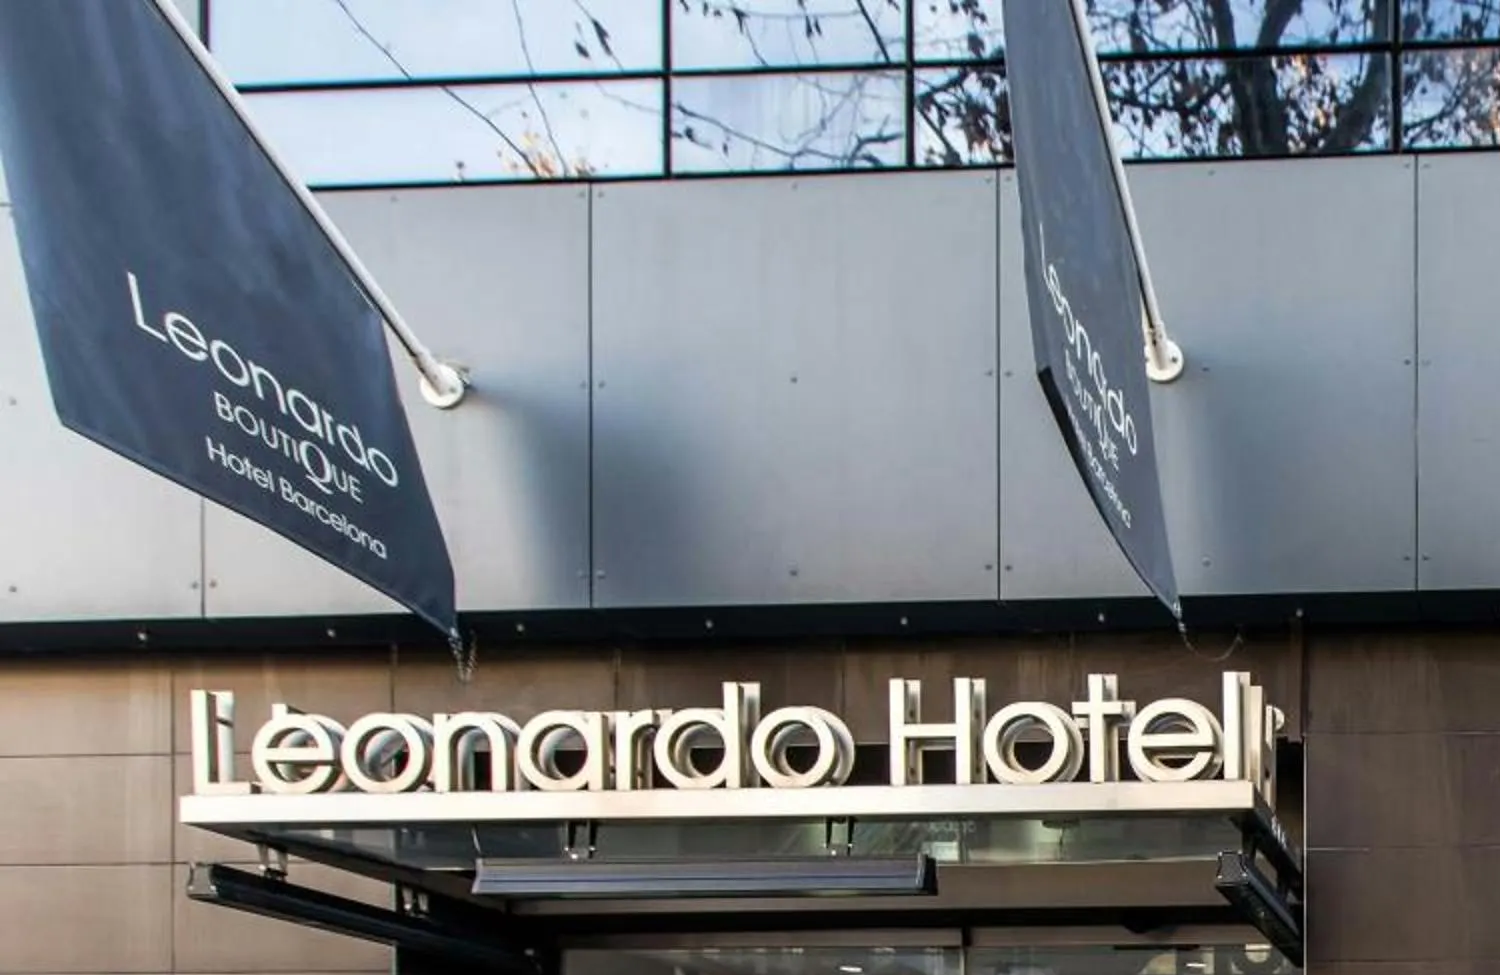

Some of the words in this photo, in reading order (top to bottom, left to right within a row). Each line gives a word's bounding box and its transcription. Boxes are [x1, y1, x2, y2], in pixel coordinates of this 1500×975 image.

[127, 271, 398, 487] Leonardo
[205, 436, 274, 492] Hotel
[280, 477, 388, 560] Barcelona
[213, 391, 363, 504] BOUTIQUE
[190, 680, 852, 795] Leonardo
[888, 671, 1251, 786] Hotel
